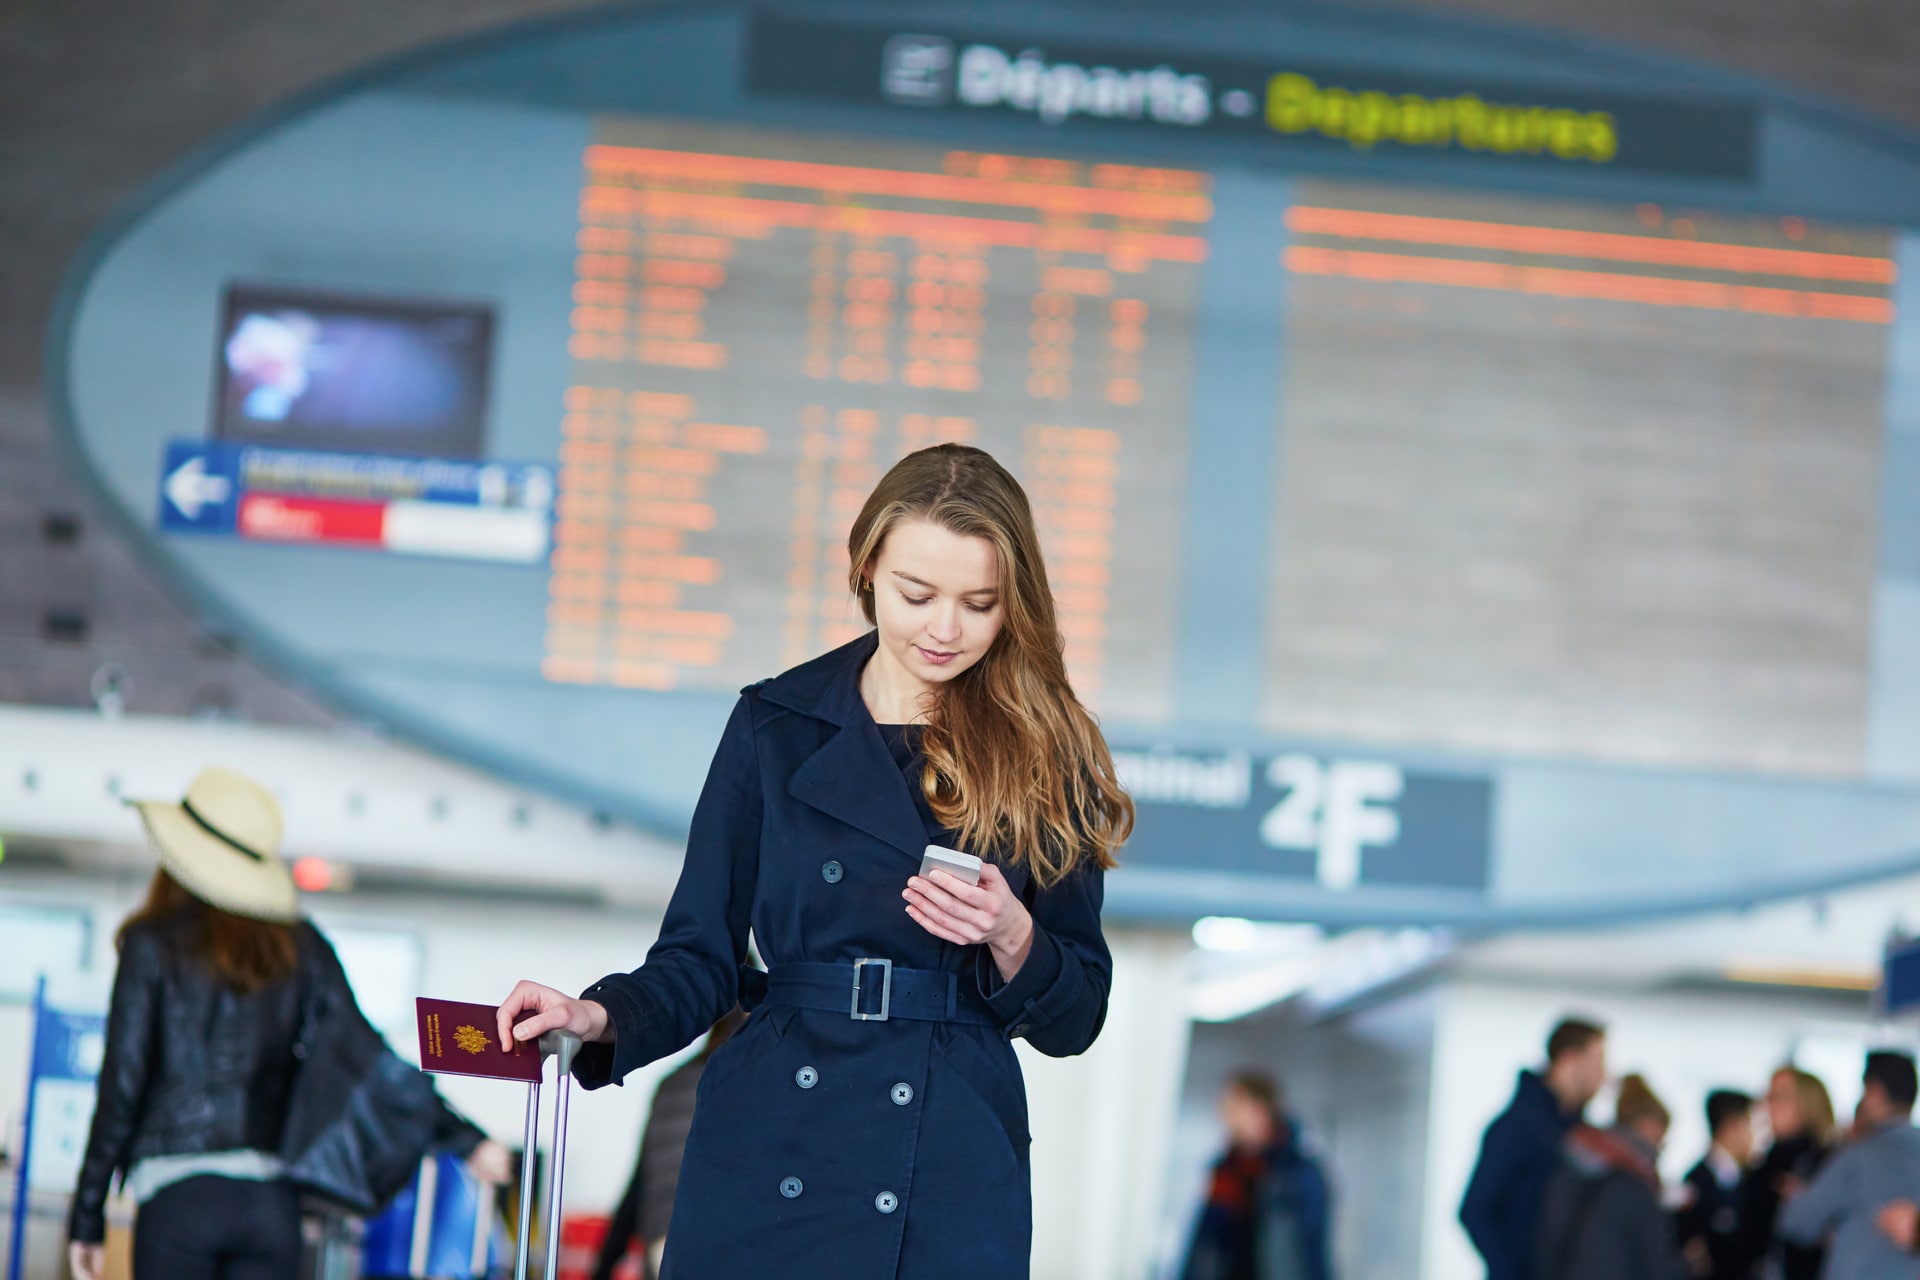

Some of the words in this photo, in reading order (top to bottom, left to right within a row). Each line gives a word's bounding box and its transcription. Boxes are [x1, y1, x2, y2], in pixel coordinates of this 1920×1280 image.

[959, 45, 1211, 125] Départs
[1266, 72, 1618, 162] Departures
[1105, 745, 1251, 808] minal
[1260, 752, 1403, 890] 2F
